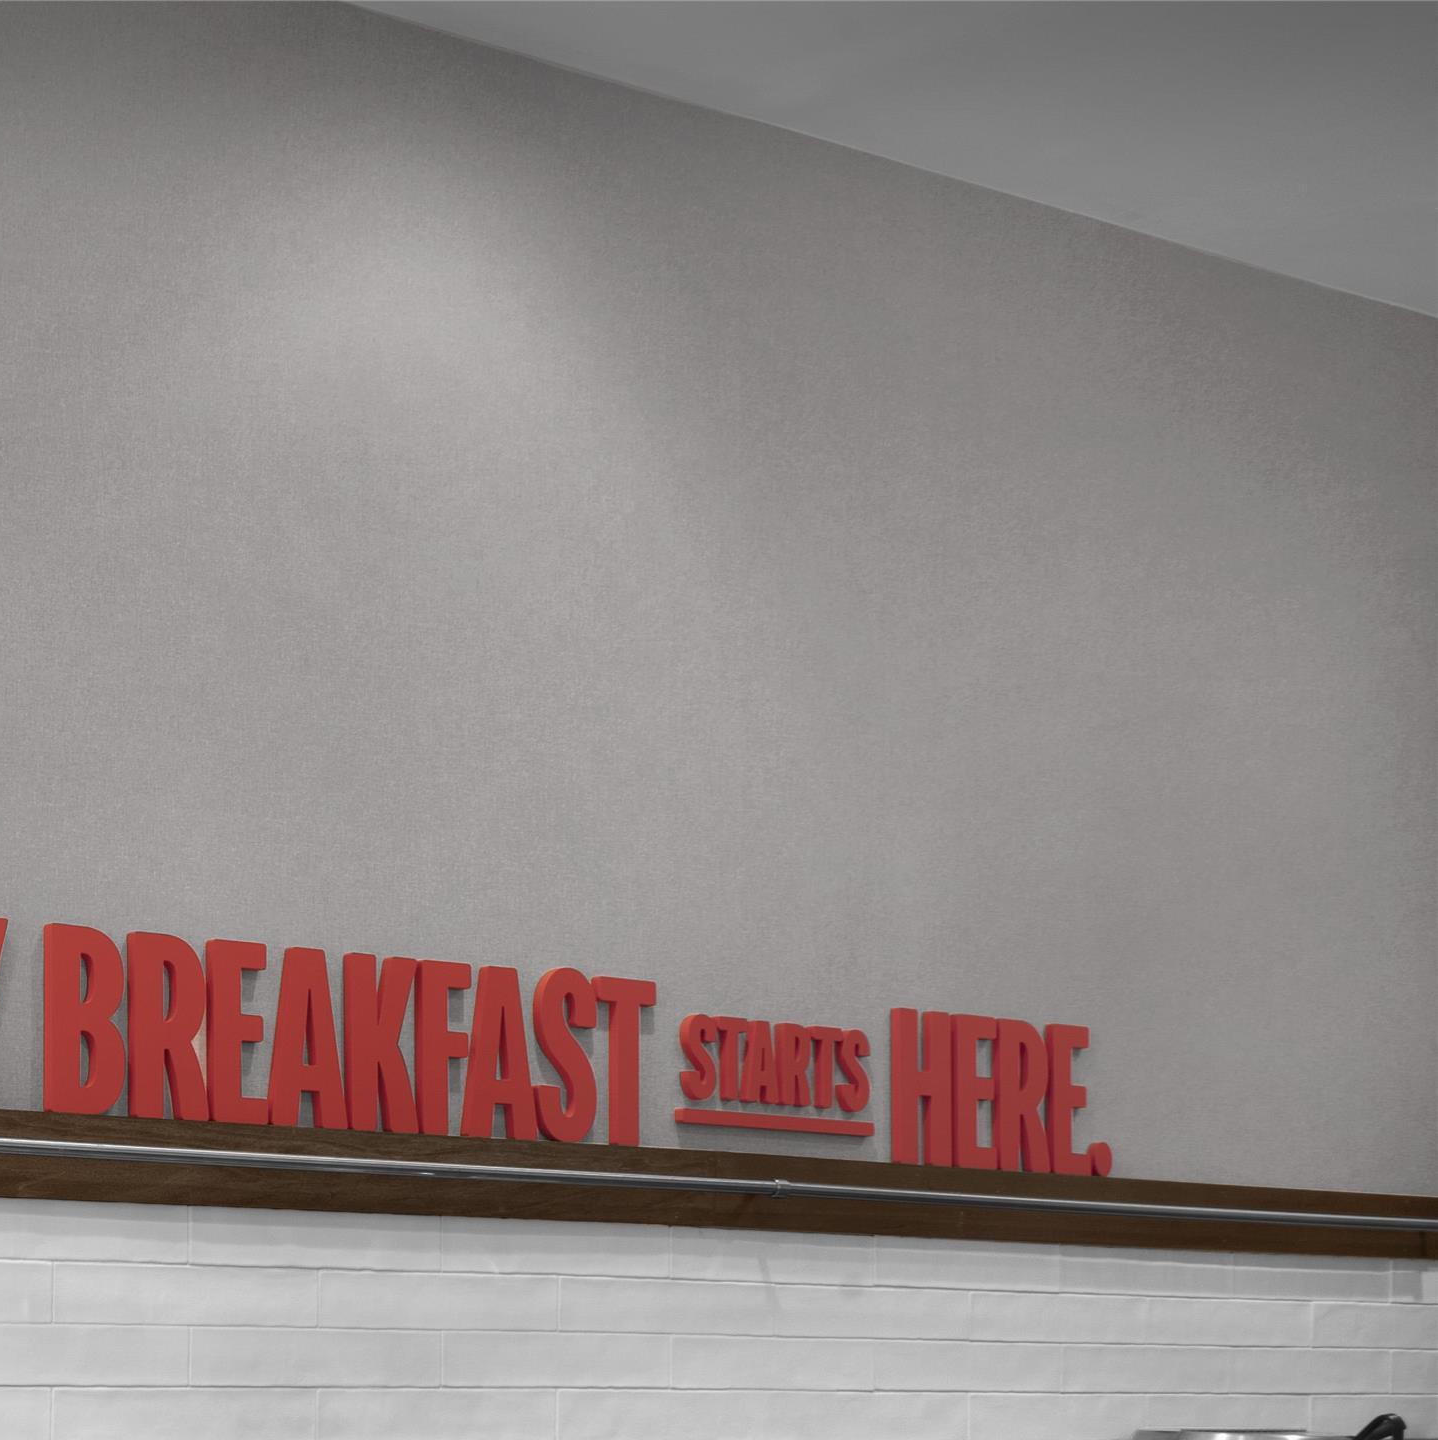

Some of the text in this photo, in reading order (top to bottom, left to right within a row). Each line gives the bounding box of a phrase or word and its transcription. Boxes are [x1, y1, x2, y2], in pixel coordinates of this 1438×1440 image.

[43, 922, 657, 1147] BREAKFAST
[679, 1013, 871, 1113] STARTS
[890, 1007, 1113, 1177] HERE.
